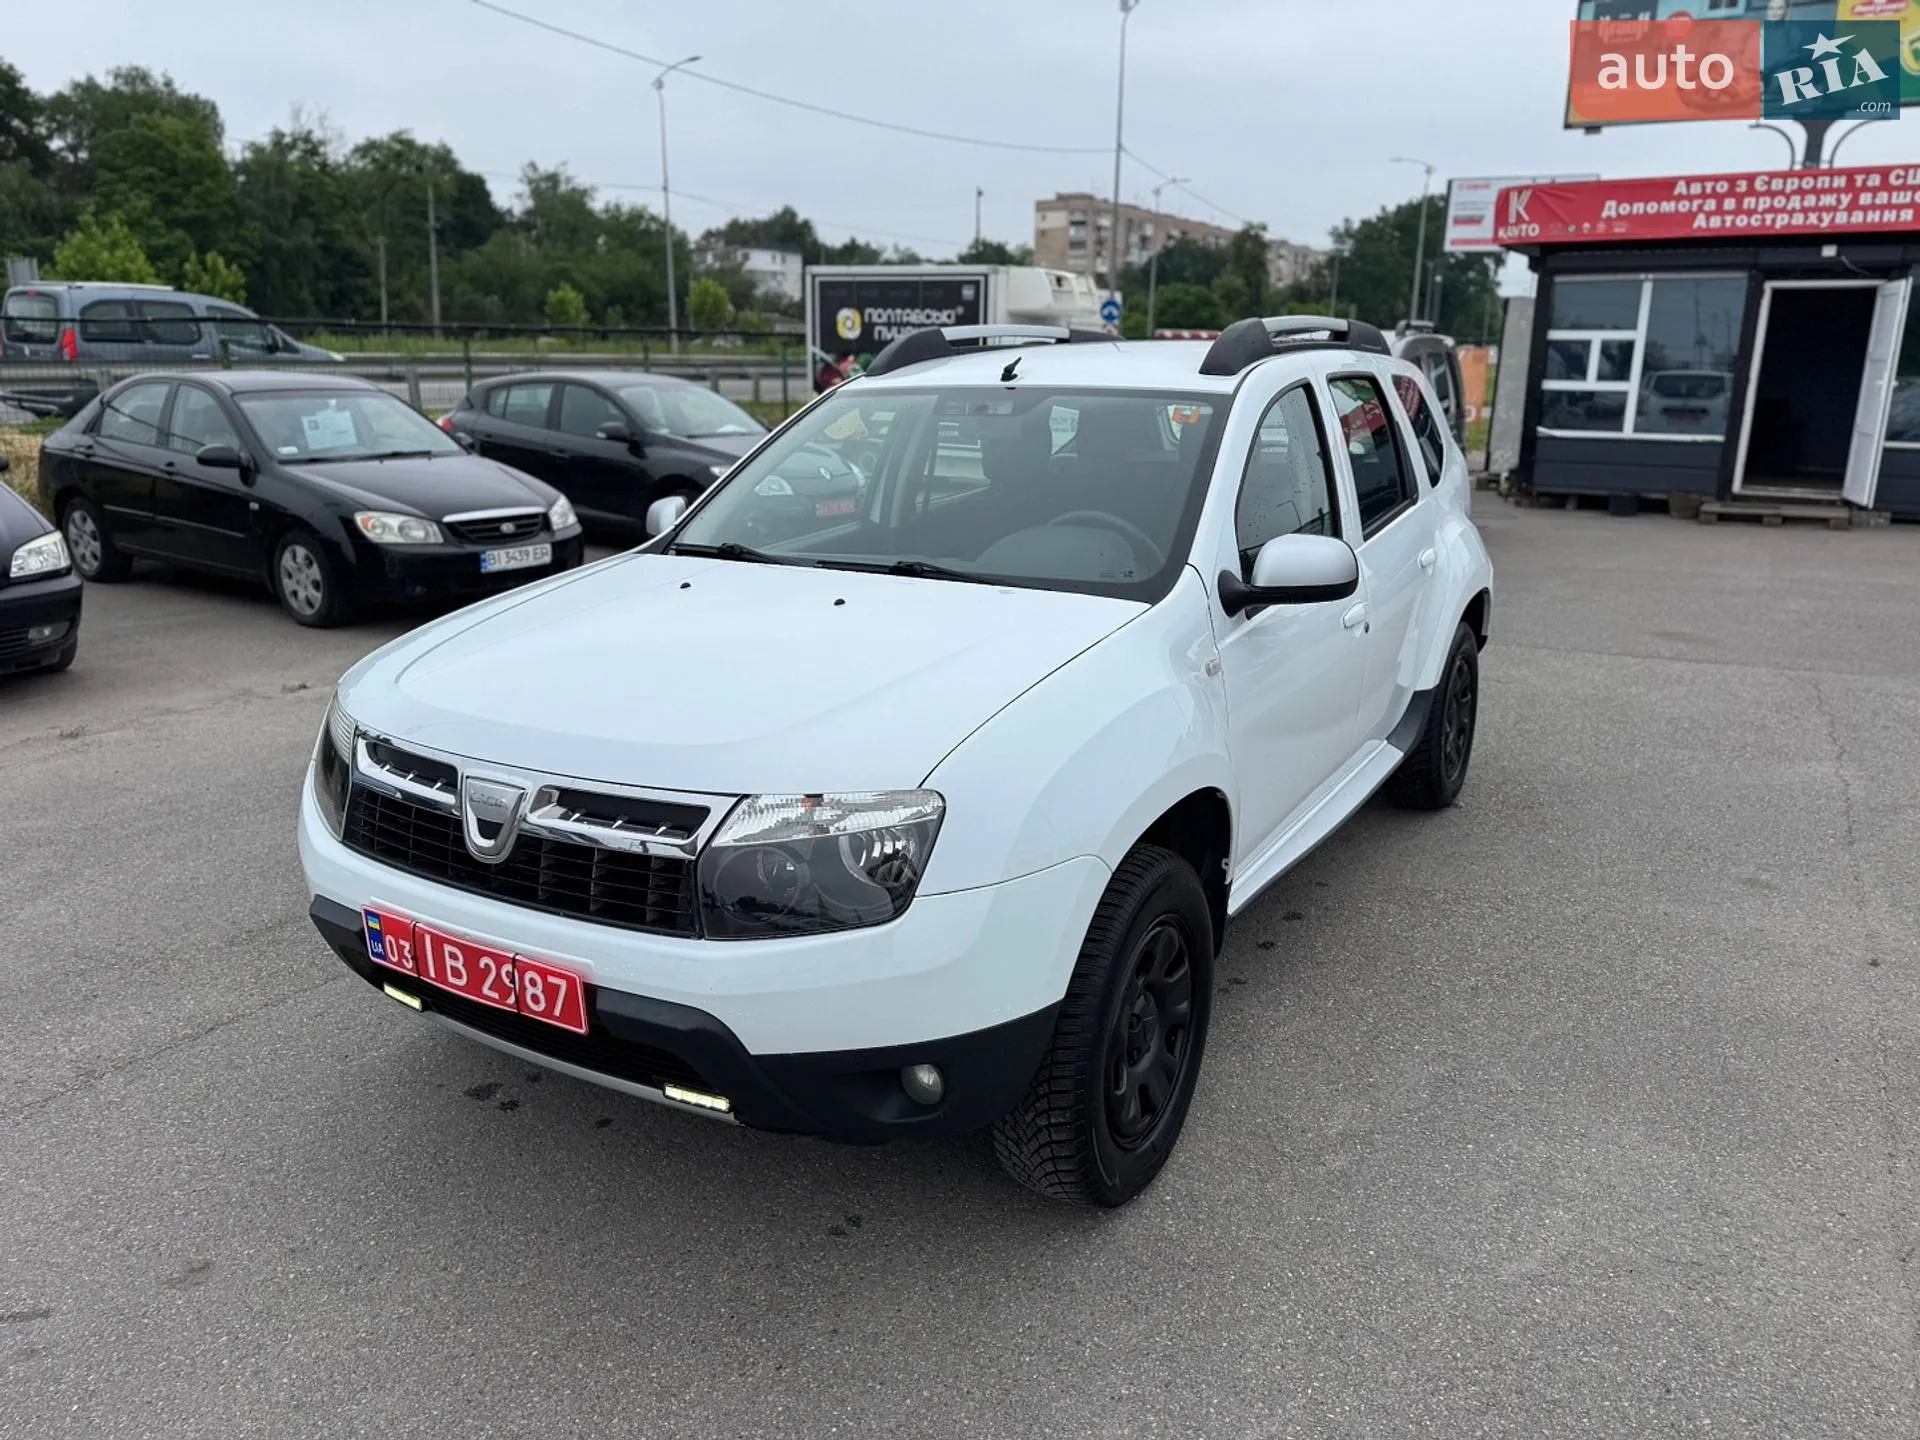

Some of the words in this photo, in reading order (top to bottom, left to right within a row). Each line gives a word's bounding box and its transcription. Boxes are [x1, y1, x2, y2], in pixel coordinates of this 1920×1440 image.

[1673, 179, 1729, 196] Авто
[1735, 178, 1748, 193] з
[1754, 173, 1847, 194] Європи
[1854, 173, 1880, 188] та
[1600, 197, 1717, 219] Допомога
[1722, 197, 1736, 211] в
[1743, 192, 1853, 213] продажу
[1692, 207, 1915, 229] Автострахування
[371, 939, 385, 956] UA
[385, 934, 414, 970] 03
[423, 933, 468, 988] IB
[478, 955, 568, 1017] 2987
